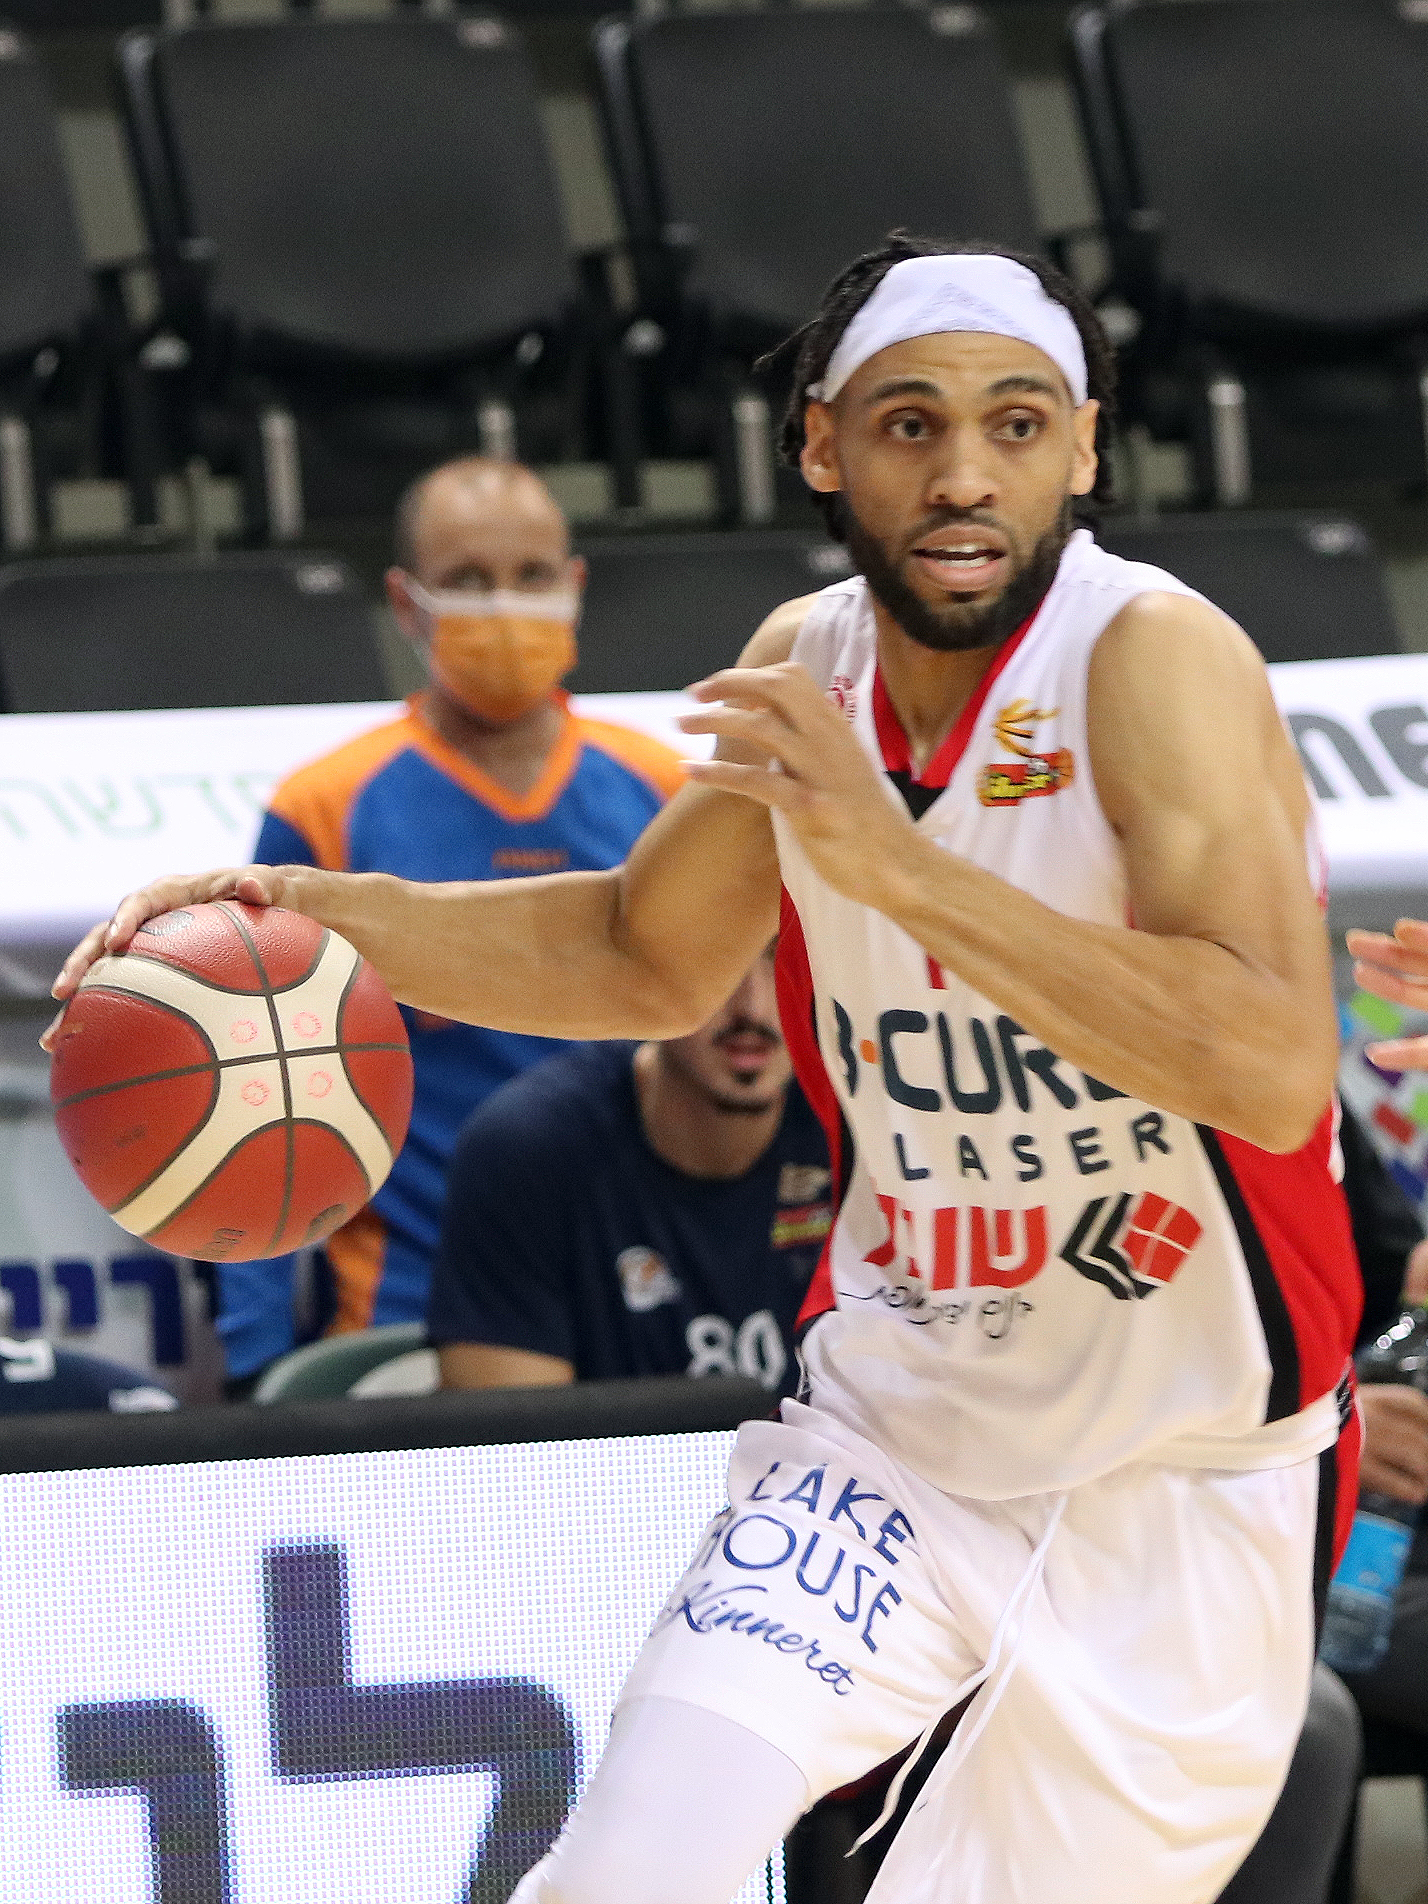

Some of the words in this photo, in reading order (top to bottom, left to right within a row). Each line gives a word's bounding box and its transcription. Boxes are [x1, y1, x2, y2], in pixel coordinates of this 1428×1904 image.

[893, 1111, 1173, 1182] LASER
[685, 1311, 789, 1392] 80
[746, 1461, 918, 1566] LAKE
